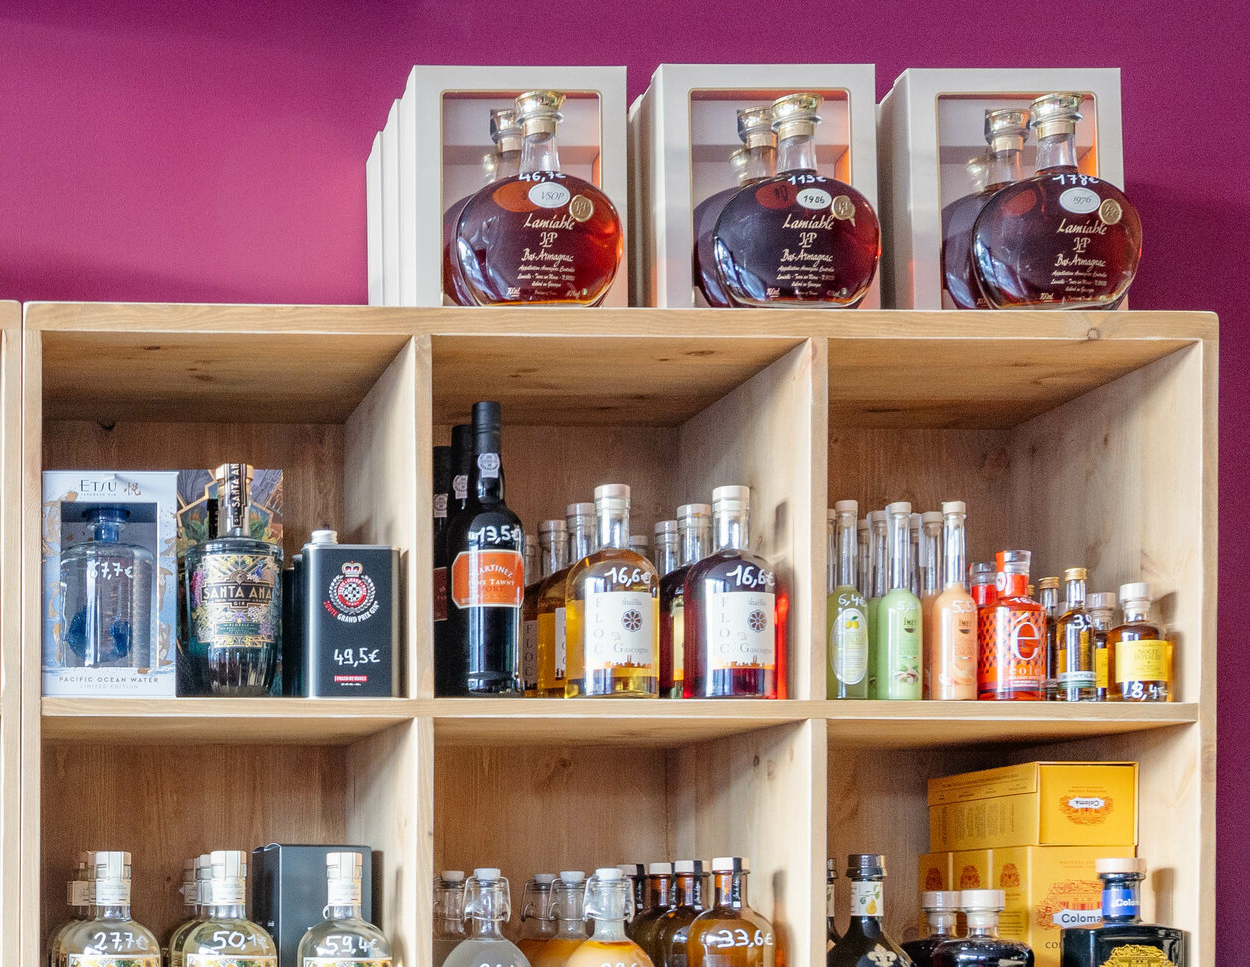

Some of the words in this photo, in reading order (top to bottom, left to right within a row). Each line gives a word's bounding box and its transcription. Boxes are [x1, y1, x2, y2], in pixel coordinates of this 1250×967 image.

[541, 191, 565, 200] VSOP
[522, 213, 576, 230] Lamiable
[782, 213, 835, 230] Lamiable
[1056, 218, 1108, 235] Lamiable
[604, 566, 650, 585] 16,6€
[726, 564, 775, 586] 16,6€
[202, 586, 246, 599] SANTA
[250, 586, 273, 600] ANA
[336, 613, 358, 624] GRAND
[358, 612, 372, 622] PRIX
[1012, 612, 1040, 661] é
[333, 647, 380, 668] 49,5€
[59, 676, 92, 684] PACIFIC
[94, 931, 149, 952] 27,7€
